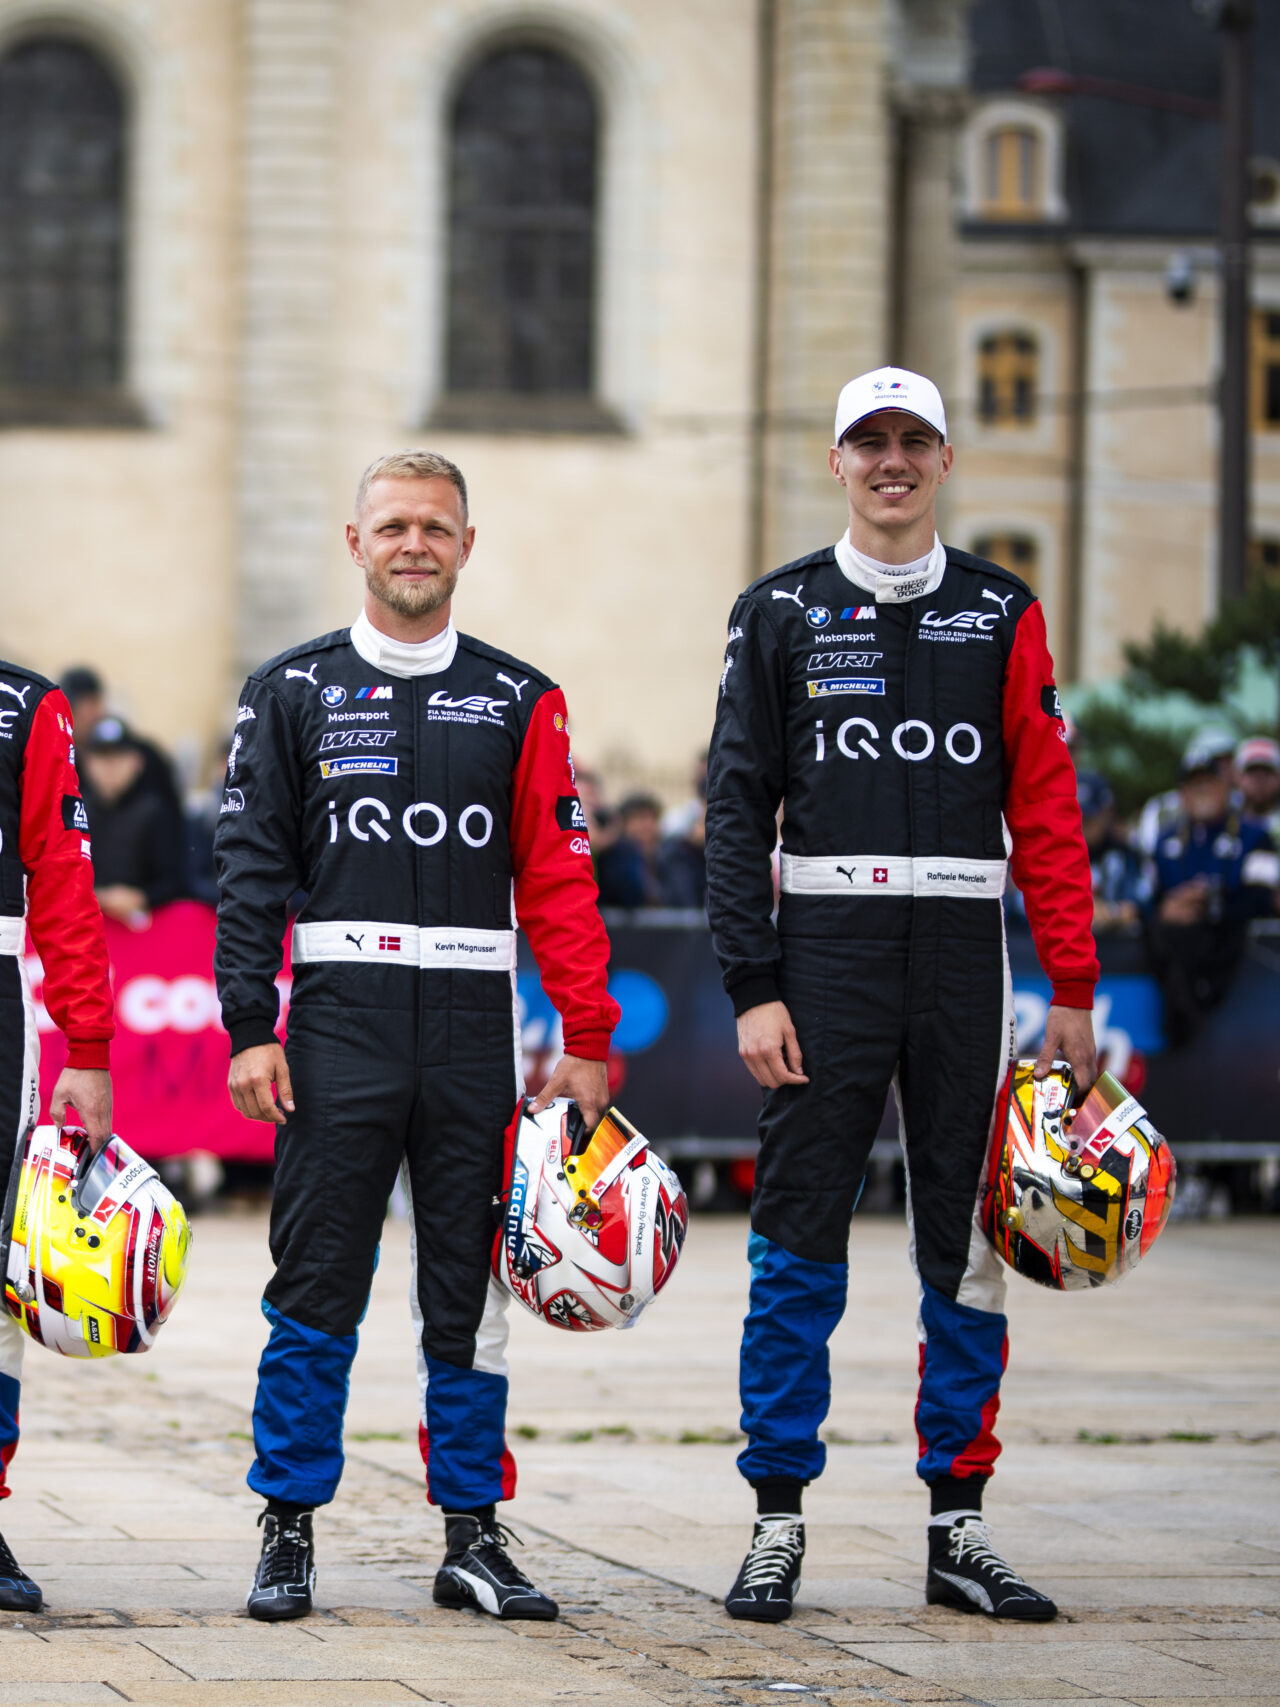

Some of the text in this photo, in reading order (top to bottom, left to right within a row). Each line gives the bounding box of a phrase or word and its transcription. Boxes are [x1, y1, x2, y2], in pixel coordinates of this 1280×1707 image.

[855, 606, 877, 620] M
[919, 611, 1000, 630] WEC
[814, 632, 876, 644] Motorsport
[953, 631, 994, 641] ENDURANCE
[806, 651, 884, 671] WRT
[371, 686, 393, 700] M
[427, 690, 510, 717] WEC
[327, 710, 390, 723] Motorsport
[427, 715, 479, 724] CHAMPIONSHIP
[465, 713, 505, 726] ENDURANCE
[319, 729, 397, 751] WRT
[815, 716, 982, 765] iQOO
[340, 761, 390, 770] MICHELIN
[327, 796, 494, 848] iQOO
[926, 872, 987, 884] Raffaele Marciello
[435, 942, 497, 953] Kevin Magnussen
[1048, 1086, 1059, 1108] BELL
[549, 1138, 558, 1160] BELL
[635, 1184, 649, 1256] Admin By Request
[147, 1226, 161, 1285] BergHOFF
